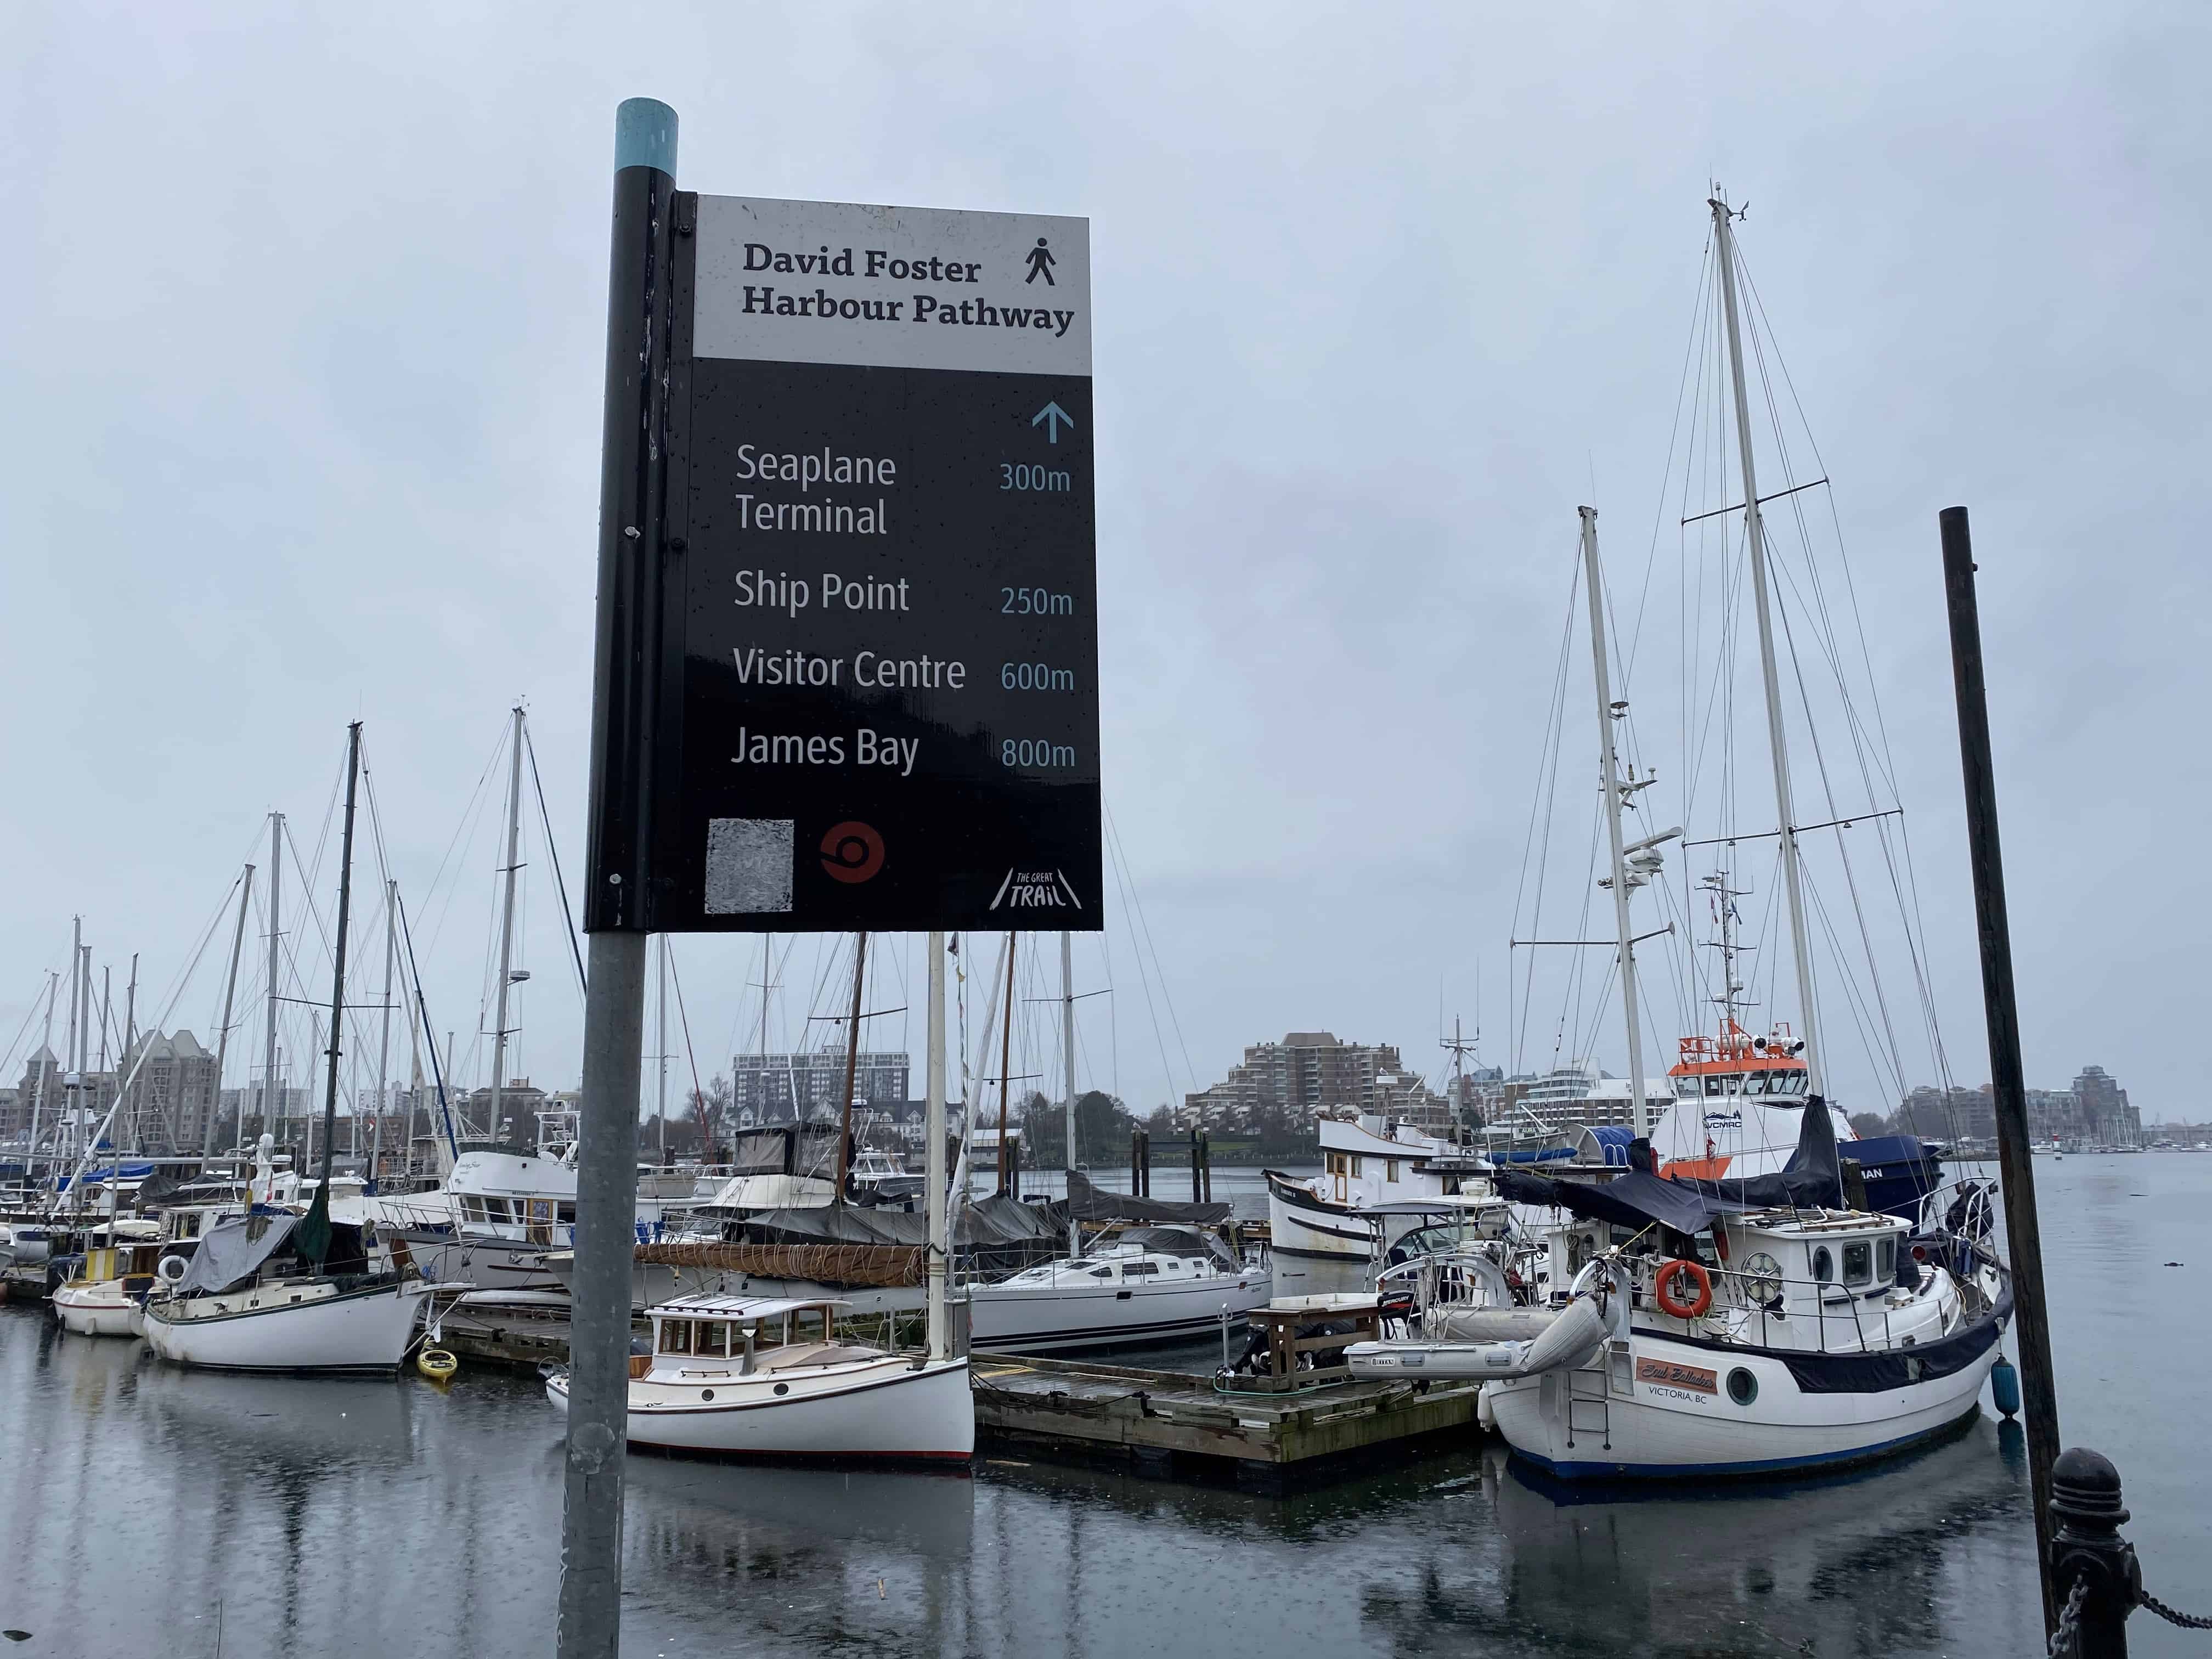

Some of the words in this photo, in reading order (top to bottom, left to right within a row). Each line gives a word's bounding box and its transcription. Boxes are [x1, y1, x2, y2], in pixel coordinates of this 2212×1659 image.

[743, 243, 855, 276] David
[864, 250, 982, 283] Foster
[742, 285, 904, 321] Harbour
[912, 295, 1075, 338] Pathway
[736, 444, 896, 492] Seaplane
[1000, 463, 1070, 492] 300m
[736, 494, 887, 534] Terminal
[734, 569, 809, 618] Ship
[822, 573, 910, 611] Point
[1001, 587, 1073, 615] 250m
[732, 647, 844, 686] Visitor
[854, 651, 966, 689] Centre
[1001, 662, 1074, 691] 600m
[731, 726, 845, 765] James
[857, 729, 919, 776] Bay
[1002, 739, 1075, 767] 800m
[1017, 872, 1030, 883] THE
[1031, 872, 1053, 883] GREAT
[1381, 1295, 1409, 1307] MERCURY
[1641, 1364, 1668, 1379] Soul
[1649, 1386, 1693, 1402] VICTORIA,
[1695, 1395, 1707, 1404] BC
